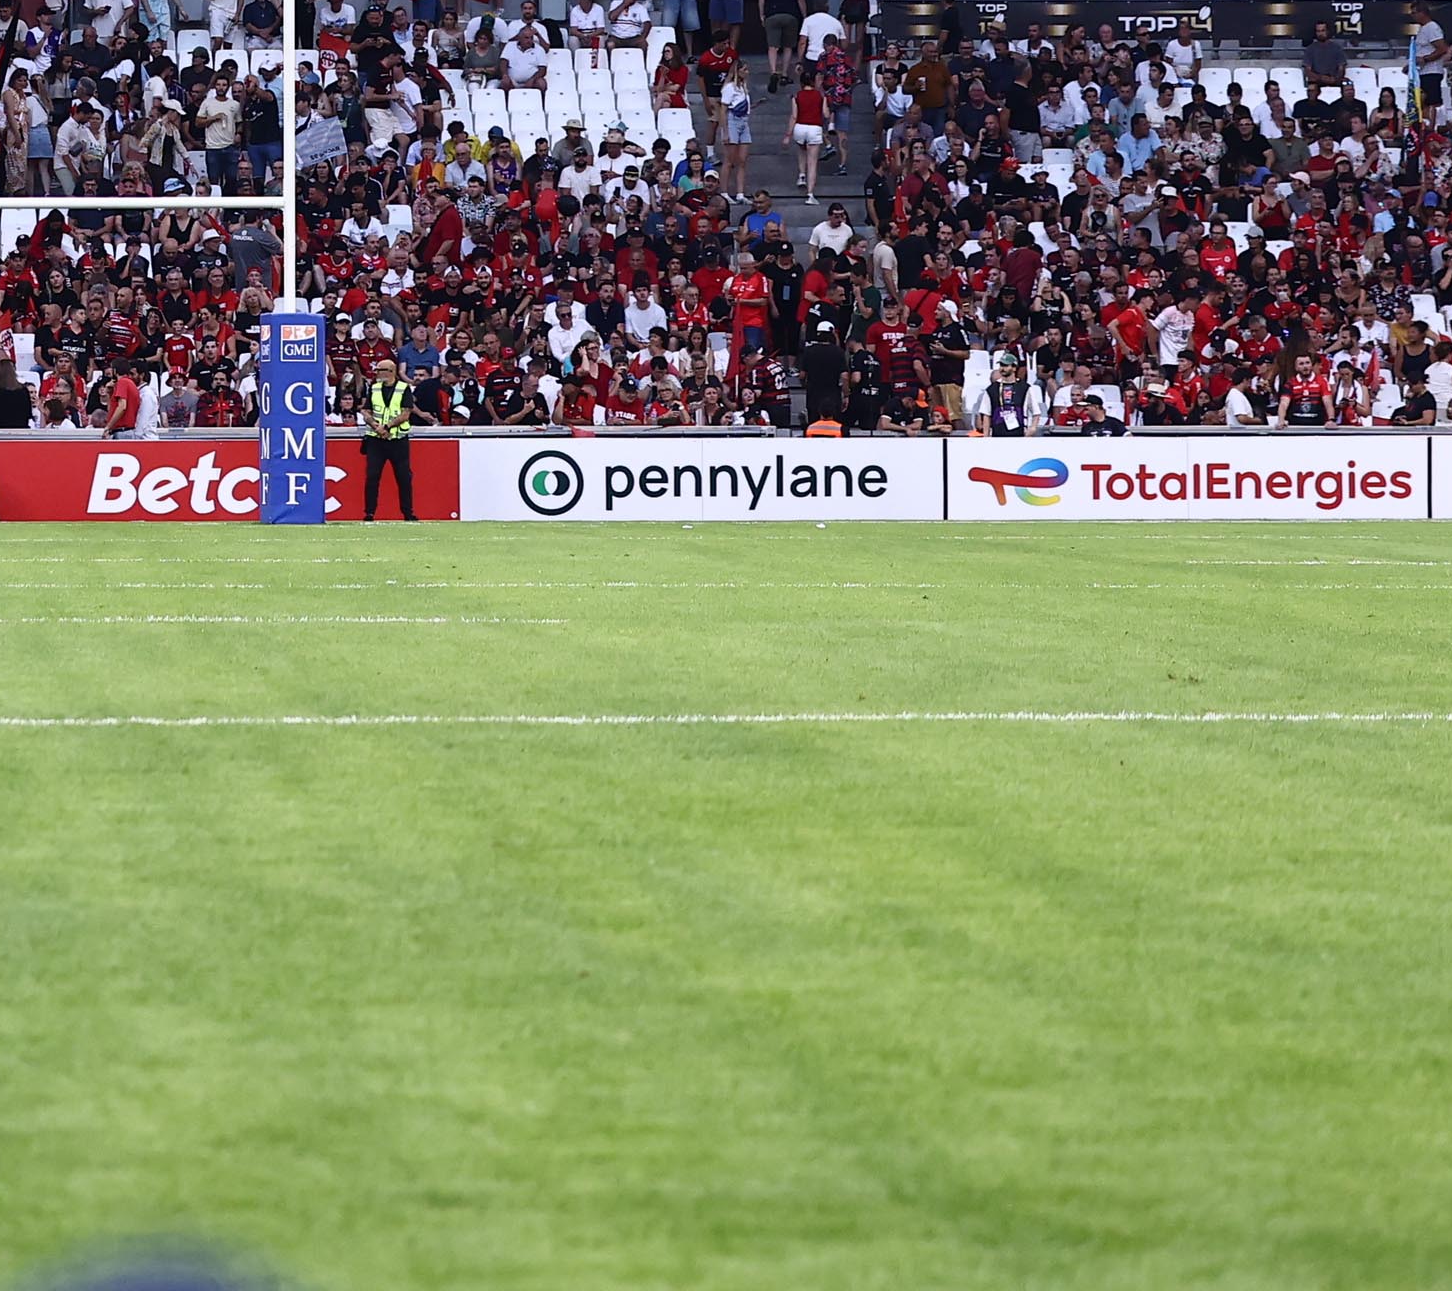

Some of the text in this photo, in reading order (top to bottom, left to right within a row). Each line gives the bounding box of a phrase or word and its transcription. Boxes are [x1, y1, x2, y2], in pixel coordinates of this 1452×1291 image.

[975, 3, 1008, 13] TOP
[1331, 2, 1364, 12] TOP
[1334, 21, 1363, 35] 14
[283, 343, 315, 357] GMF
[605, 454, 888, 511] pennylane
[1081, 460, 1412, 511] TotalEnergies
